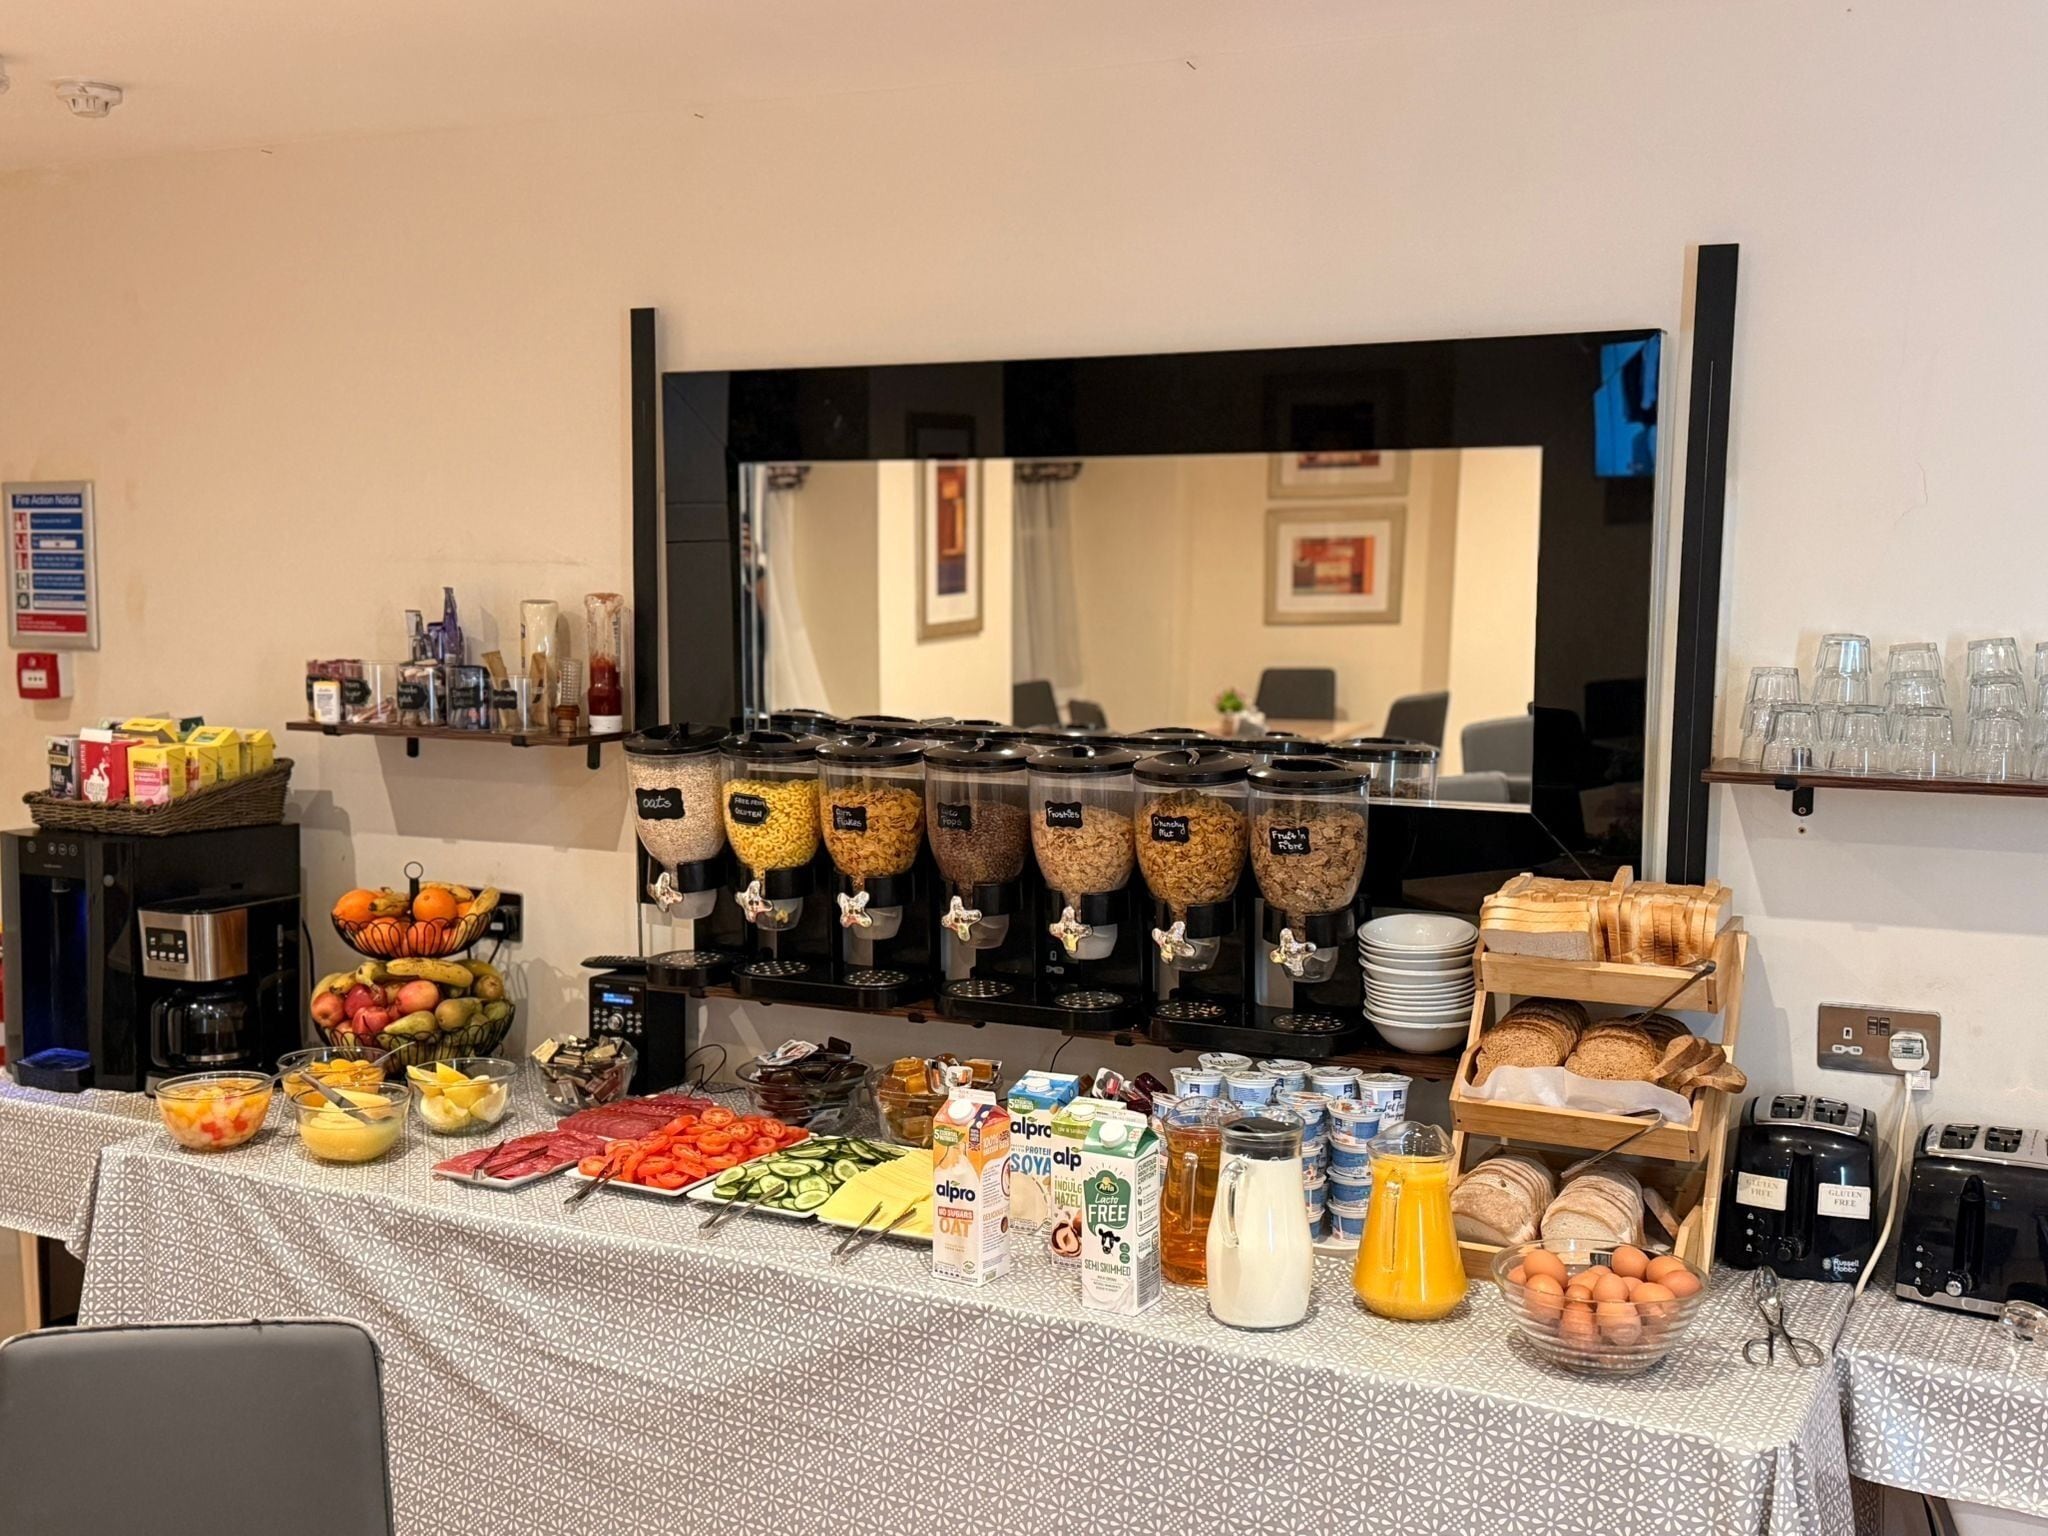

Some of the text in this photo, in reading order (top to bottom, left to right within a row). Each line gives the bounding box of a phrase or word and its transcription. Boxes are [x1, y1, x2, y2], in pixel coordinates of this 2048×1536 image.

[16, 495, 79, 505] Fire Action Notice
[642, 795, 672, 809] oats
[1153, 816, 1186, 835] Crunchy
[1158, 828, 1175, 838] Nut
[1010, 1116, 1052, 1140] alpro
[933, 1129, 940, 1140] 5
[1010, 1153, 1052, 1176] SOYA
[1053, 1146, 1082, 1172] alp
[1054, 1180, 1082, 1194] INDULG
[1099, 1184, 1115, 1192] Arla
[1746, 1179, 1779, 1189] GLUTEN
[936, 1180, 976, 1203] alpro
[1750, 1188, 1773, 1198] FREE
[1828, 1190, 1862, 1199] GLUTEN
[1054, 1191, 1082, 1208] HAZEL
[1095, 1193, 1119, 1204] Lacto
[1833, 1199, 1857, 1208] FREE
[939, 1207, 973, 1219] NO SUGARS
[1088, 1204, 1127, 1223] FREE
[940, 1217, 973, 1238] OAT
[1084, 1259, 1131, 1277] SEMI SKIMMED
[1833, 1258, 1859, 1267] Russell
[1833, 1265, 1857, 1273] Hobbs
